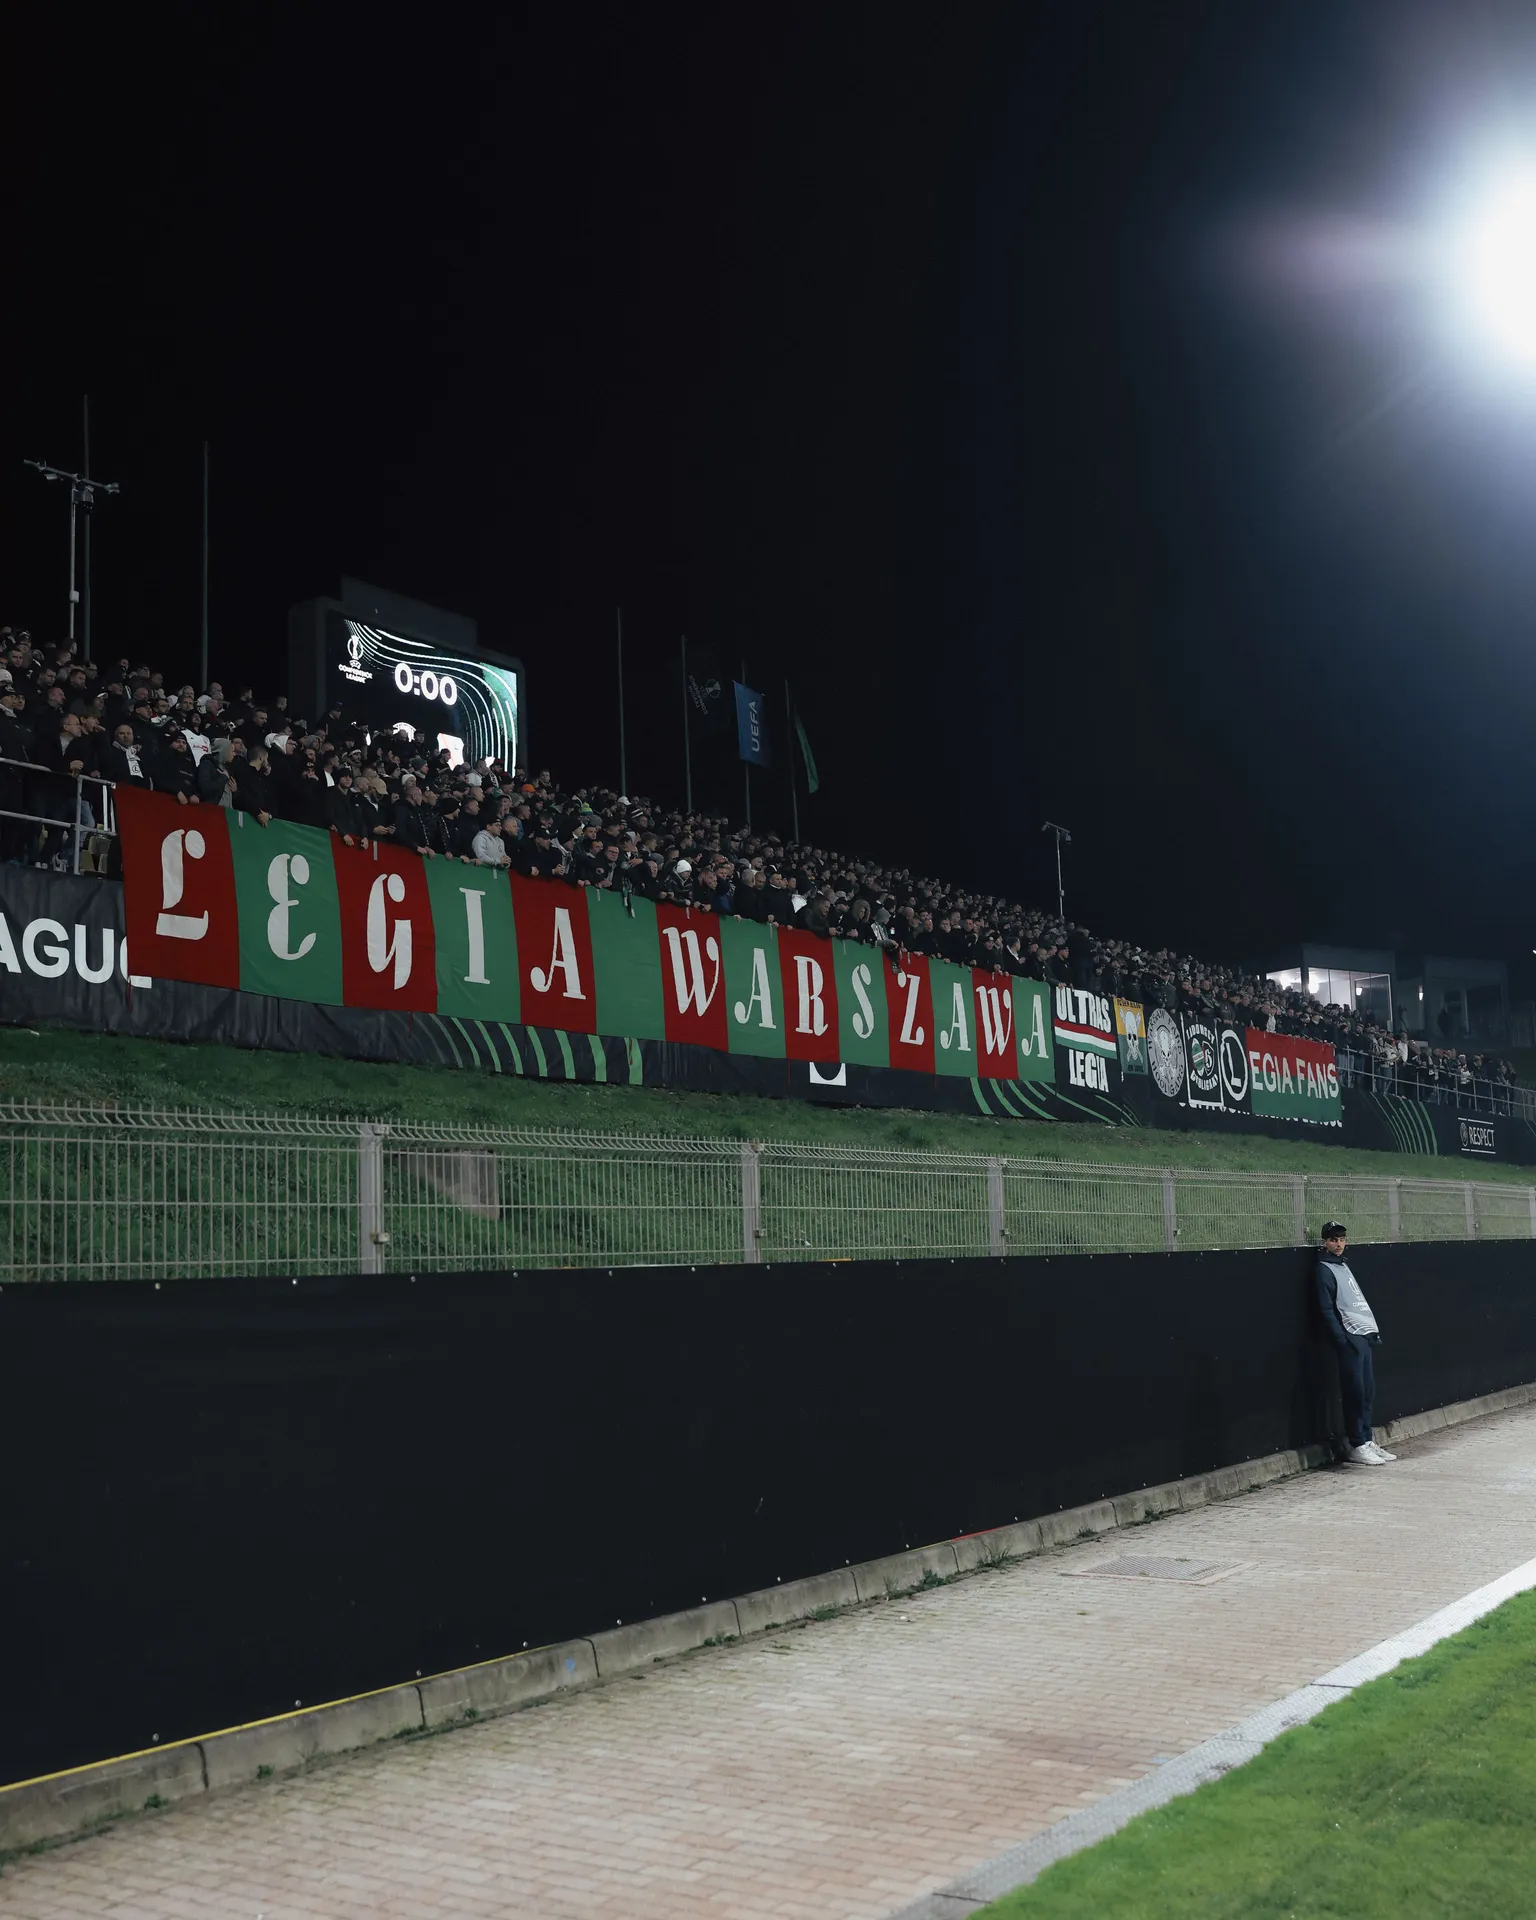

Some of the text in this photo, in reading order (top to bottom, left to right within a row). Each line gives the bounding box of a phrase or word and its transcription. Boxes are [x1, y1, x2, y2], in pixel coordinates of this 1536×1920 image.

[394, 662, 458, 706] 0:00
[749, 701, 760, 753] UEFA
[156, 829, 1049, 1059] LEGIA WARSZAWA
[1055, 986, 1112, 1034] ULTRAS
[1068, 1049, 1110, 1093] LEGIA
[1296, 1056, 1339, 1100] FANS
[1468, 1126, 1495, 1148] RESPECT
